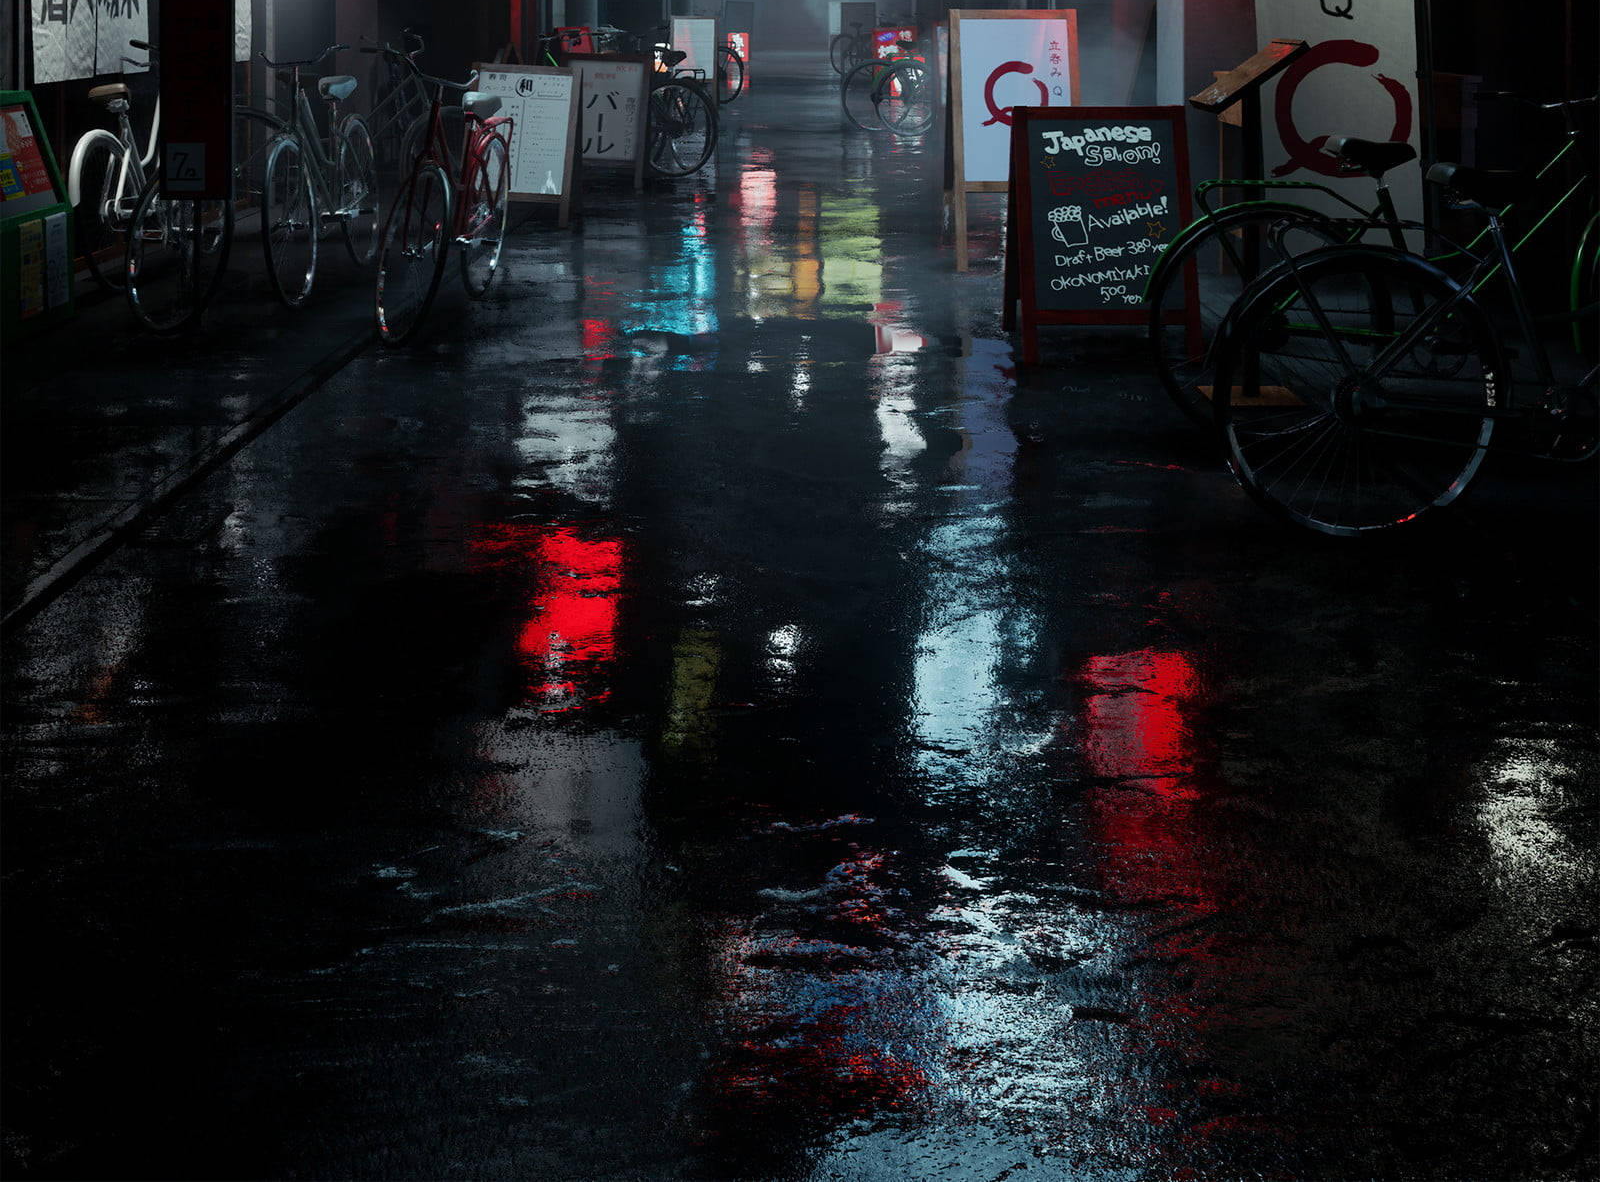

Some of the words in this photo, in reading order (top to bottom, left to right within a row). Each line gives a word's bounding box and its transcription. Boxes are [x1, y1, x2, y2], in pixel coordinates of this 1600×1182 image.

[1042, 125, 1152, 156] Japanese
[1088, 195, 1169, 232] Available!
[1093, 245, 1125, 261] Beer
